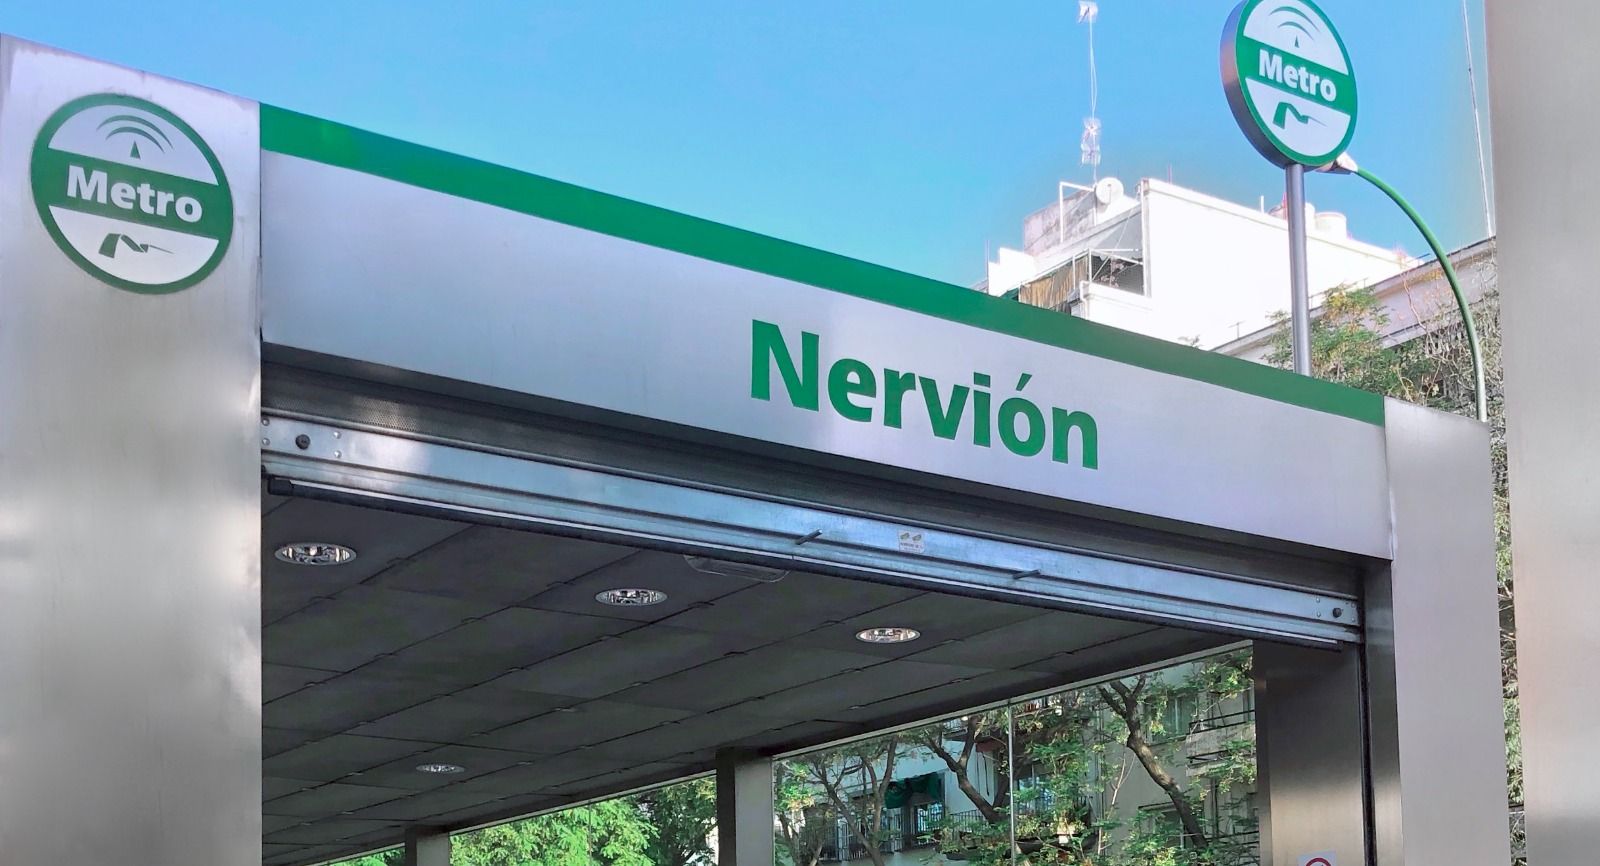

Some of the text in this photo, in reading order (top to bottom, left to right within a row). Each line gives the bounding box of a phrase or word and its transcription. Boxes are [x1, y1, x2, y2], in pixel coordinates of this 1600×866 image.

[1259, 49, 1337, 102] Metro
[67, 165, 203, 223] Metro
[751, 319, 1098, 470] Nervión
